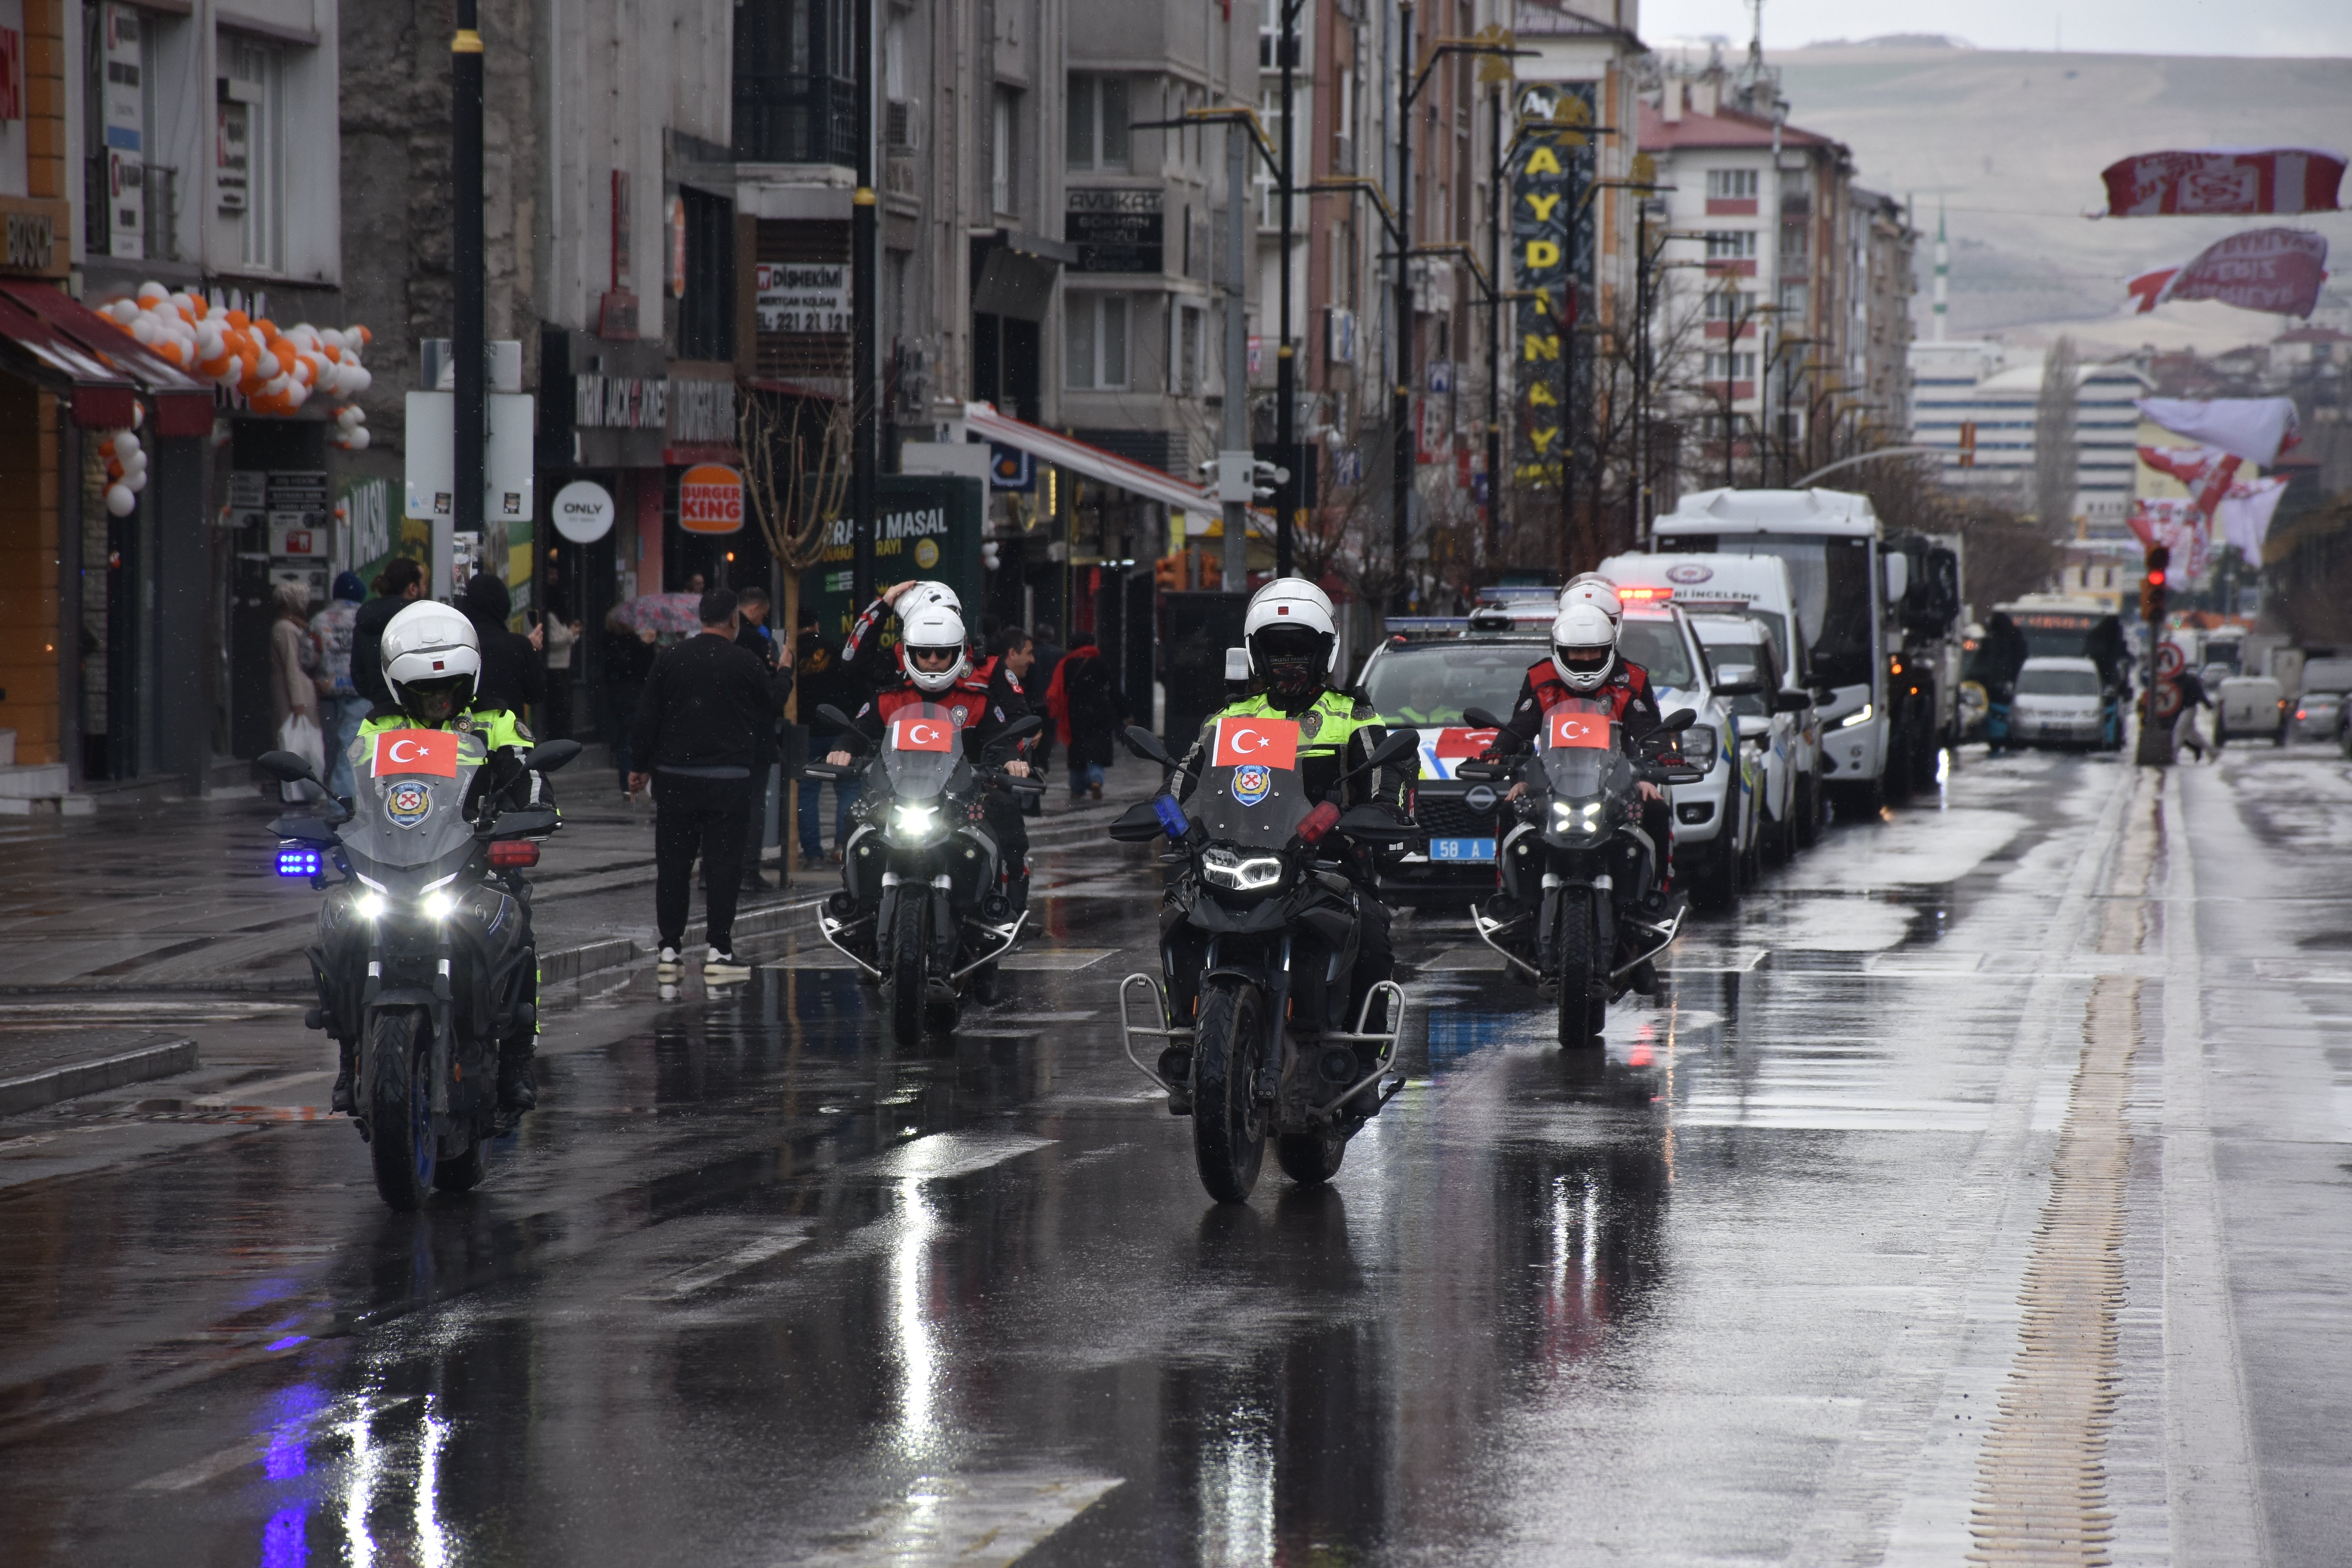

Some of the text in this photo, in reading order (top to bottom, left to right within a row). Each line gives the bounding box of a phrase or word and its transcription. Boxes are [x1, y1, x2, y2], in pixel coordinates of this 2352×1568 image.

[1069, 193, 1160, 209] AVUKAT
[7, 212, 54, 269] BOSCH
[777, 312, 800, 331] 221
[806, 312, 820, 331] 21
[828, 313, 843, 331] 12
[682, 486, 740, 500] BURGER
[564, 503, 603, 515] ONLY
[682, 500, 741, 520] KING
[886, 508, 948, 539] MASAL
[1691, 589, 1761, 601] İNCELEME
[1440, 841, 1459, 857] 58
[1472, 841, 1480, 857] A
